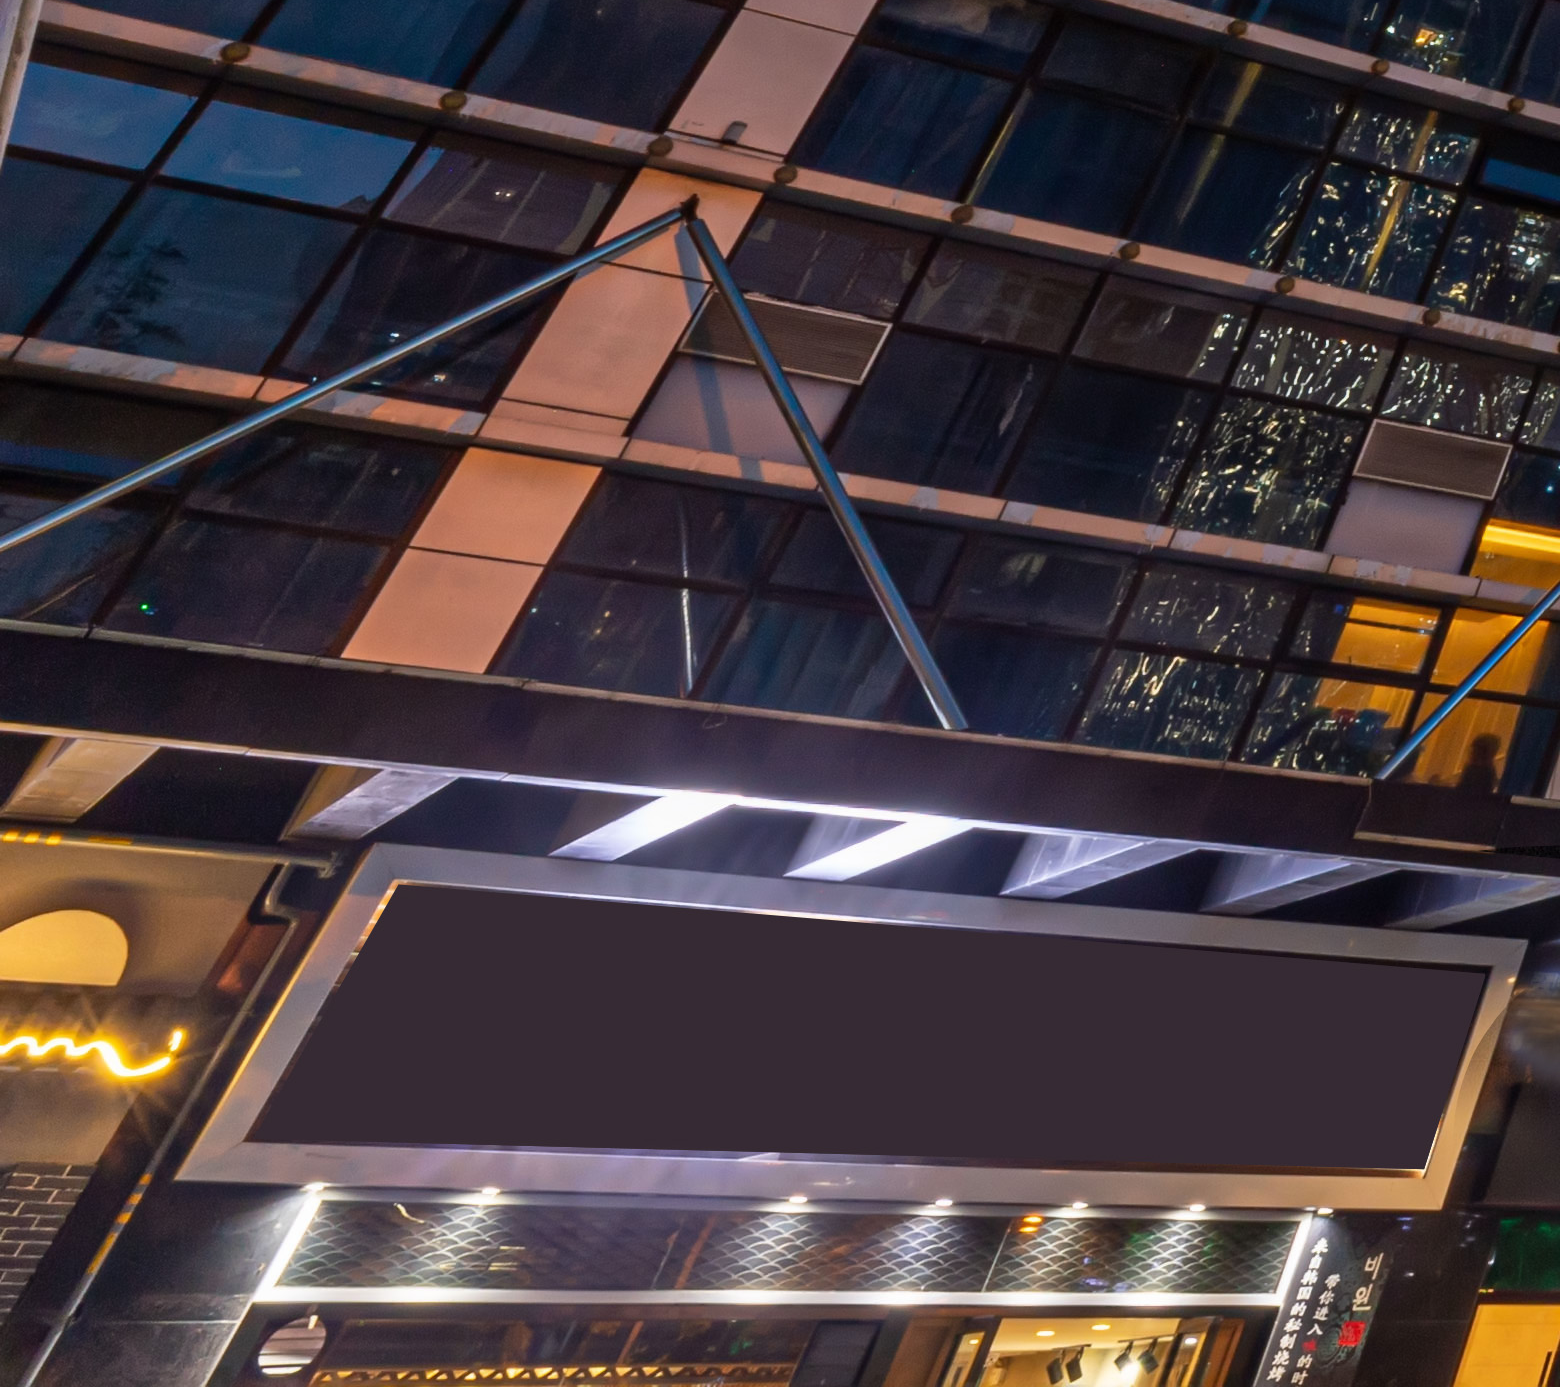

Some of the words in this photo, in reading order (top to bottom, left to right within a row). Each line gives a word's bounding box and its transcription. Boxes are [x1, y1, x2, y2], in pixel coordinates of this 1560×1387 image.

[1267, 1237, 1329, 1383] 来自韩国的秘制烧烤
[1352, 1252, 1384, 1312] 비원
